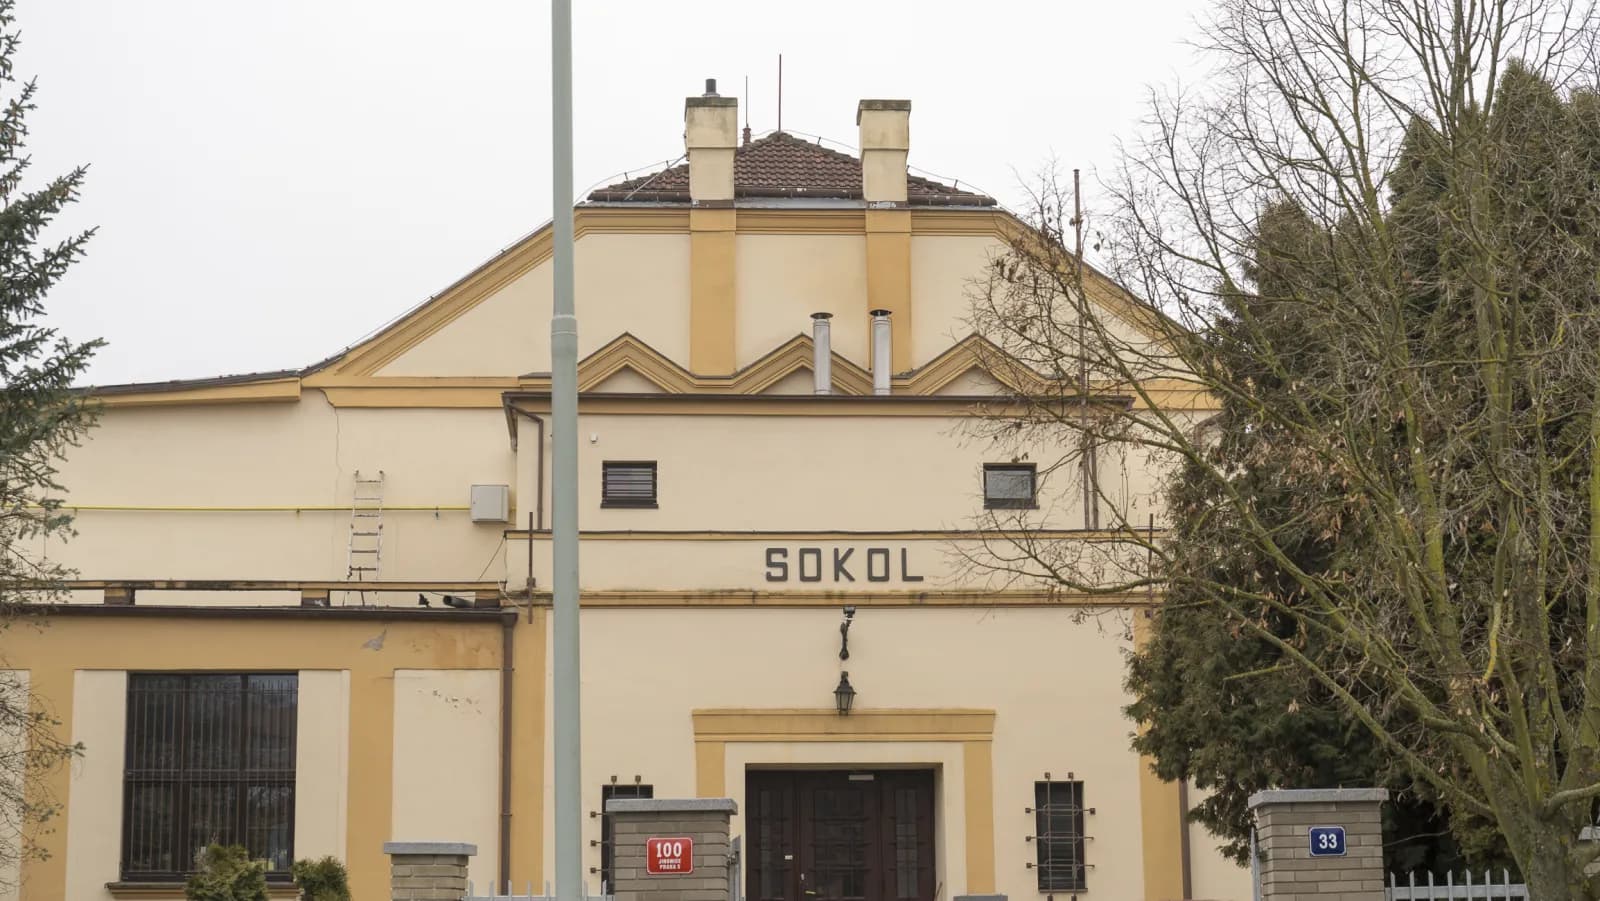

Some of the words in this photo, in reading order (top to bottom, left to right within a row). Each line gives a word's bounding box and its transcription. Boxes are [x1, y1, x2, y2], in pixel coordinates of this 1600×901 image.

[765, 547, 924, 583] SOKOL
[1319, 833, 1337, 849] 33
[656, 842, 682, 858] 100
